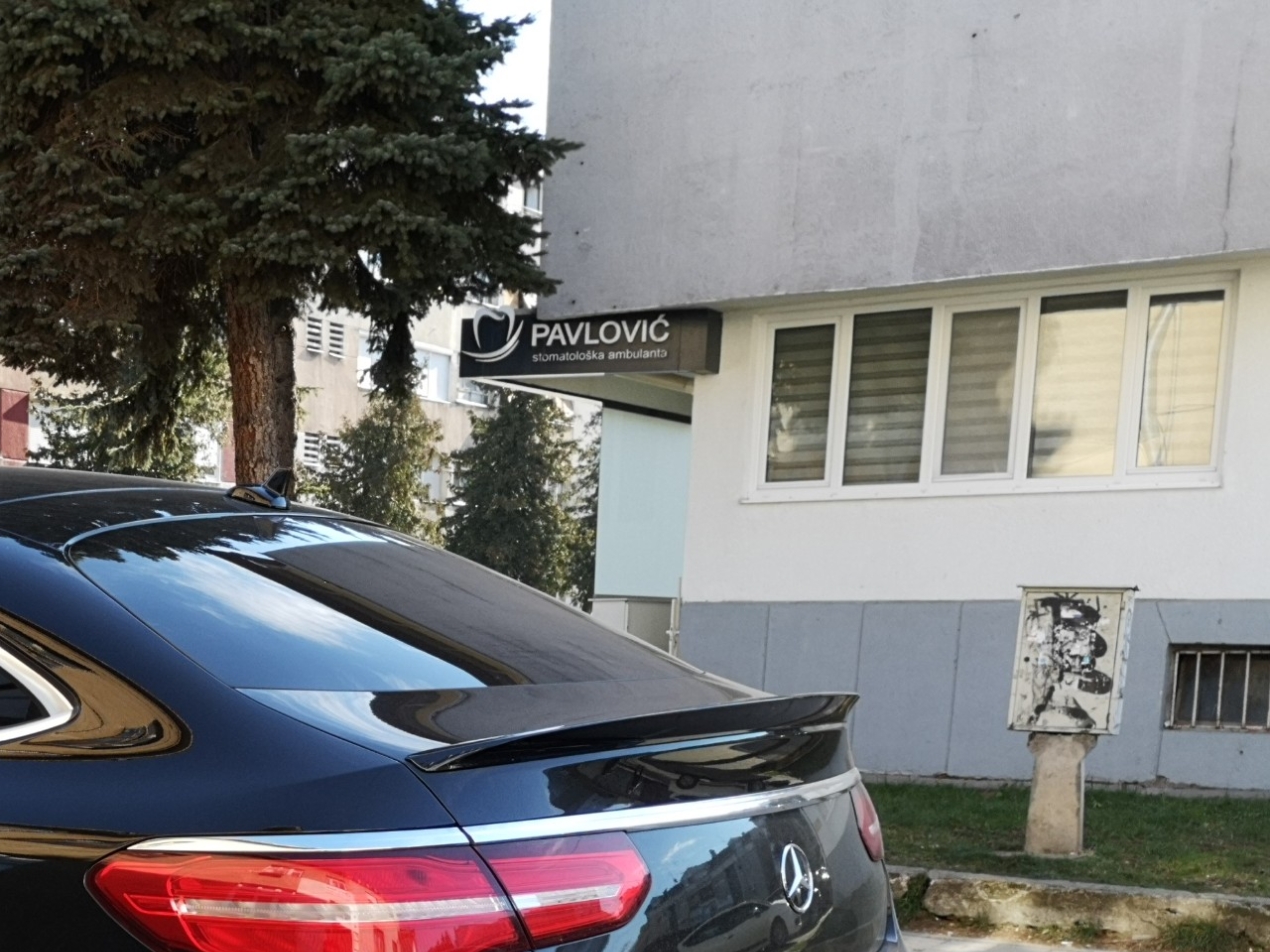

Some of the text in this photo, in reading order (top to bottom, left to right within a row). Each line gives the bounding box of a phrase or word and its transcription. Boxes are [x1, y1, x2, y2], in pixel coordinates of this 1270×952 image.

[530, 314, 670, 347] PAVLOVIĆ
[532, 349, 667, 363] stomatološka ambulanta
